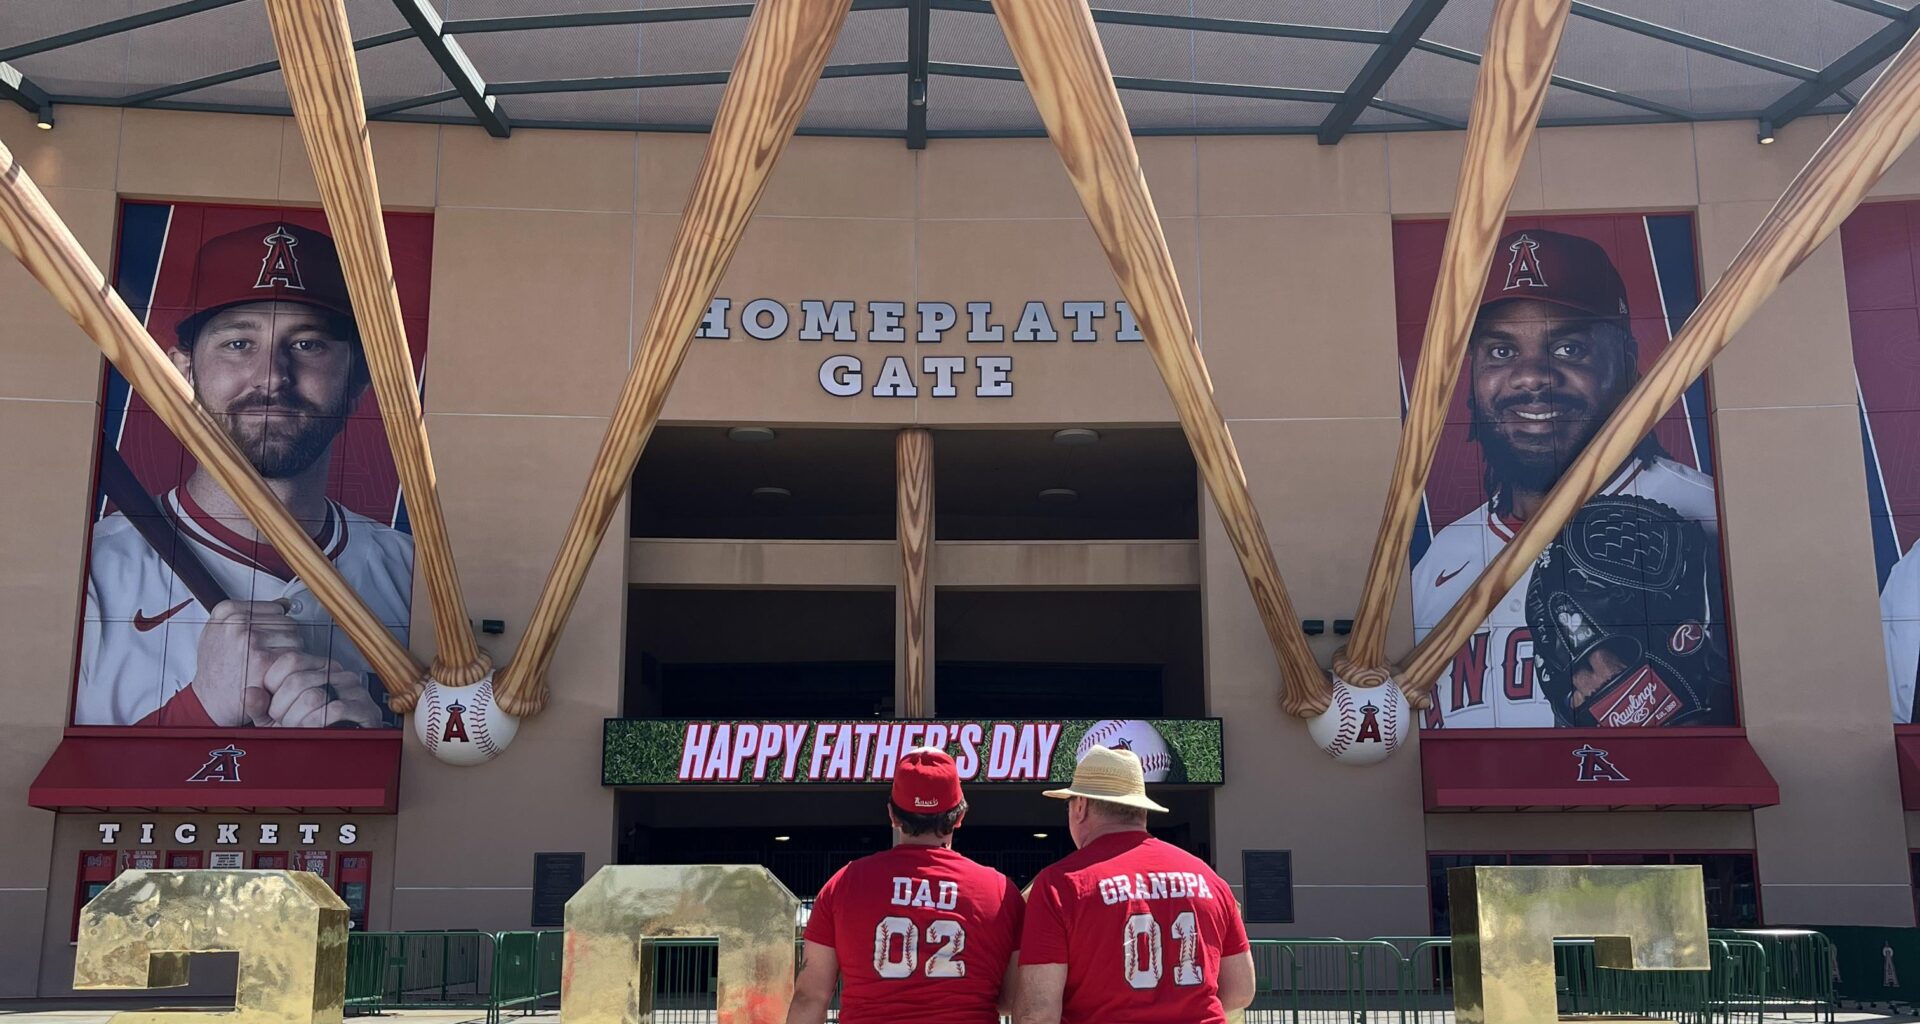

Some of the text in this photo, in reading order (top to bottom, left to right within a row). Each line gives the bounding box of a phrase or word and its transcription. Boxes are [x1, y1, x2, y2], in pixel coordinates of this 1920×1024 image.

[253, 226, 306, 290] A
[1503, 234, 1549, 291] A
[818, 354, 1014, 398] GATE
[442, 698, 469, 742] A
[1355, 699, 1382, 743] A
[1608, 681, 1657, 727] Rawlings
[186, 743, 247, 782] A
[678, 723, 807, 780] HAPPY
[986, 723, 1062, 780] DAY
[1571, 743, 1631, 782] A
[99, 822, 359, 845] TICKETS
[891, 876, 958, 911] DAD
[1098, 872, 1213, 906] GRANDPA
[873, 916, 966, 979] 02
[1122, 911, 1204, 989] 01
